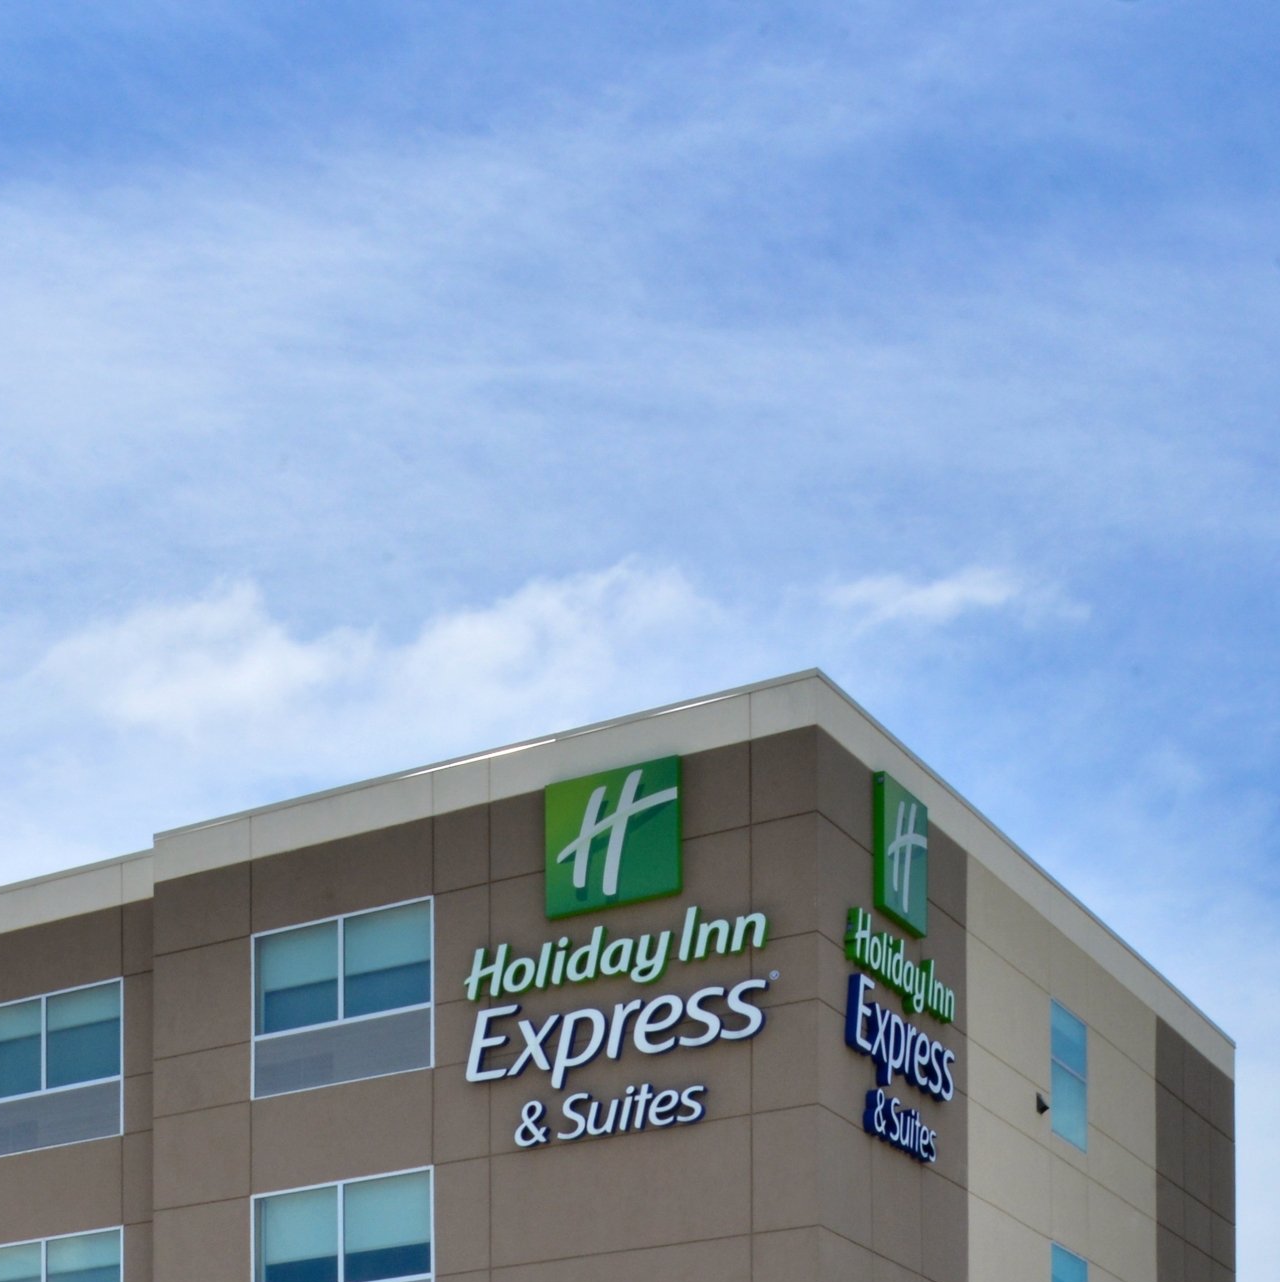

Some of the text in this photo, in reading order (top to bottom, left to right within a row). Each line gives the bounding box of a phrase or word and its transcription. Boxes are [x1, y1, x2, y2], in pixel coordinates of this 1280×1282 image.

[464, 905, 767, 1001] Holiday Inn
[854, 907, 955, 1023] Holiday Inn
[465, 979, 768, 1090] Express
[854, 973, 955, 1101] Express
[514, 1083, 706, 1147] & Suites
[874, 1087, 936, 1162] & Suites
